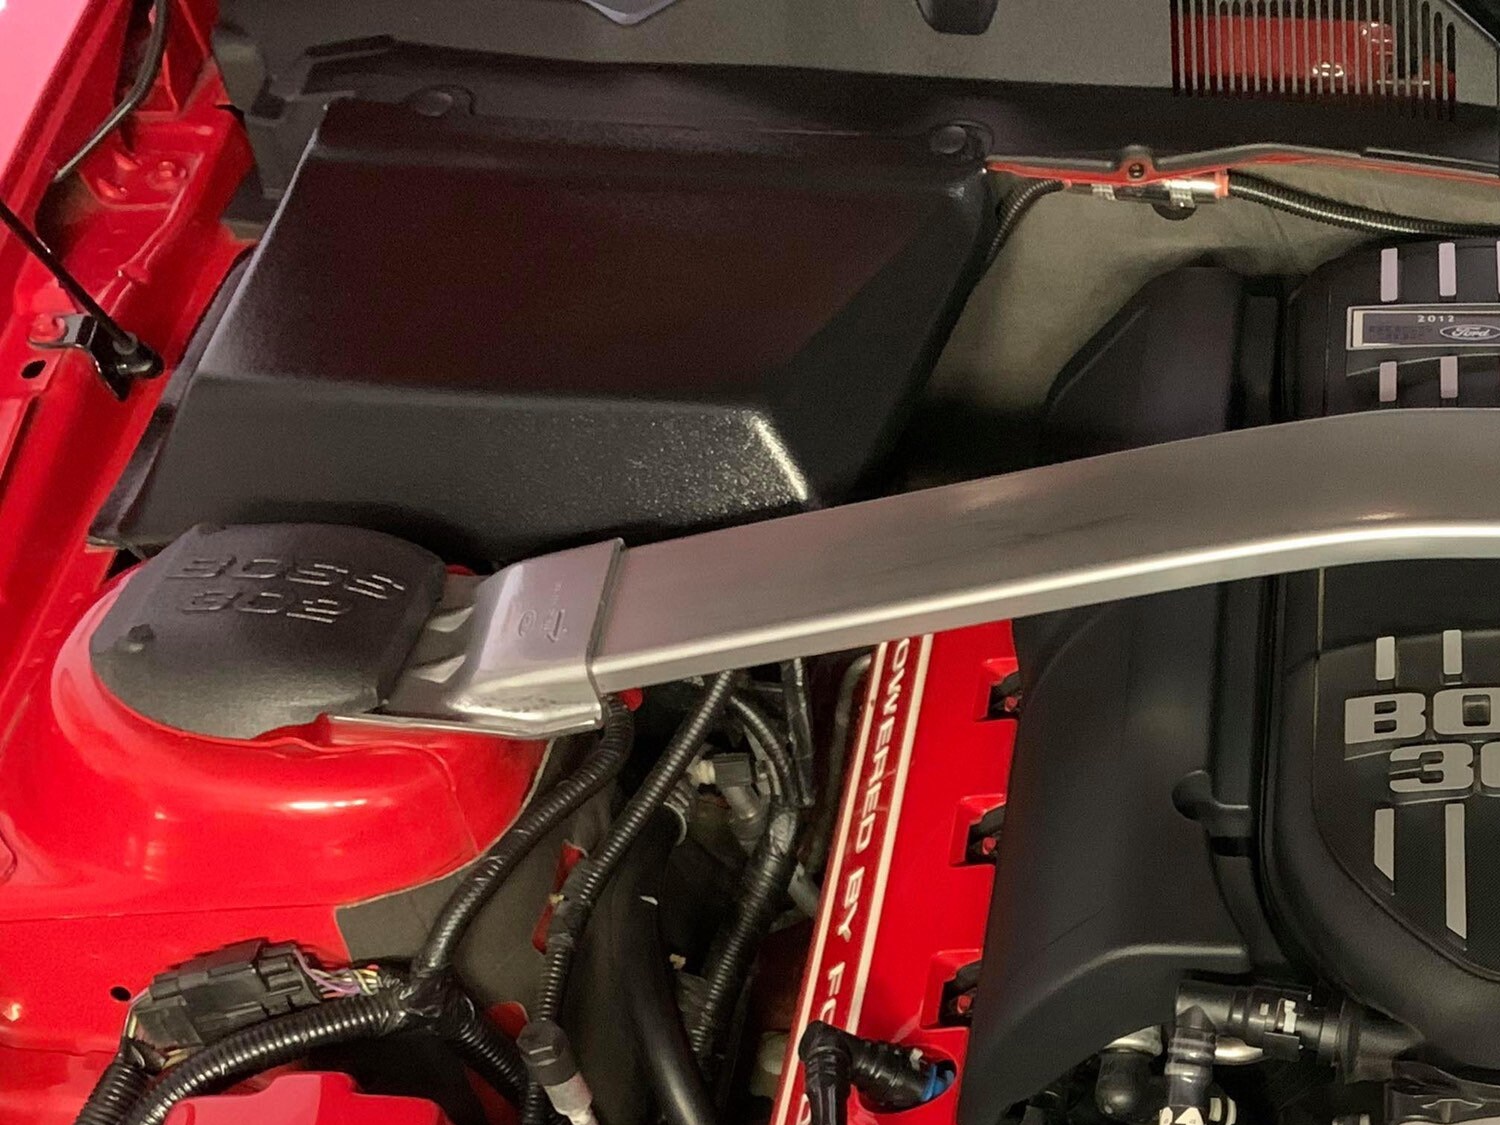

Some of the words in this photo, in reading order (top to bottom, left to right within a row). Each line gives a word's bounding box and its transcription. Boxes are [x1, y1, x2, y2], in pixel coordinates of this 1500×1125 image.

[1417, 315, 1455, 324] 2012
[1449, 326, 1493, 339] Ford
[167, 555, 405, 599] BOSS
[855, 637, 911, 854] OWERED
[838, 866, 866, 943] BY
